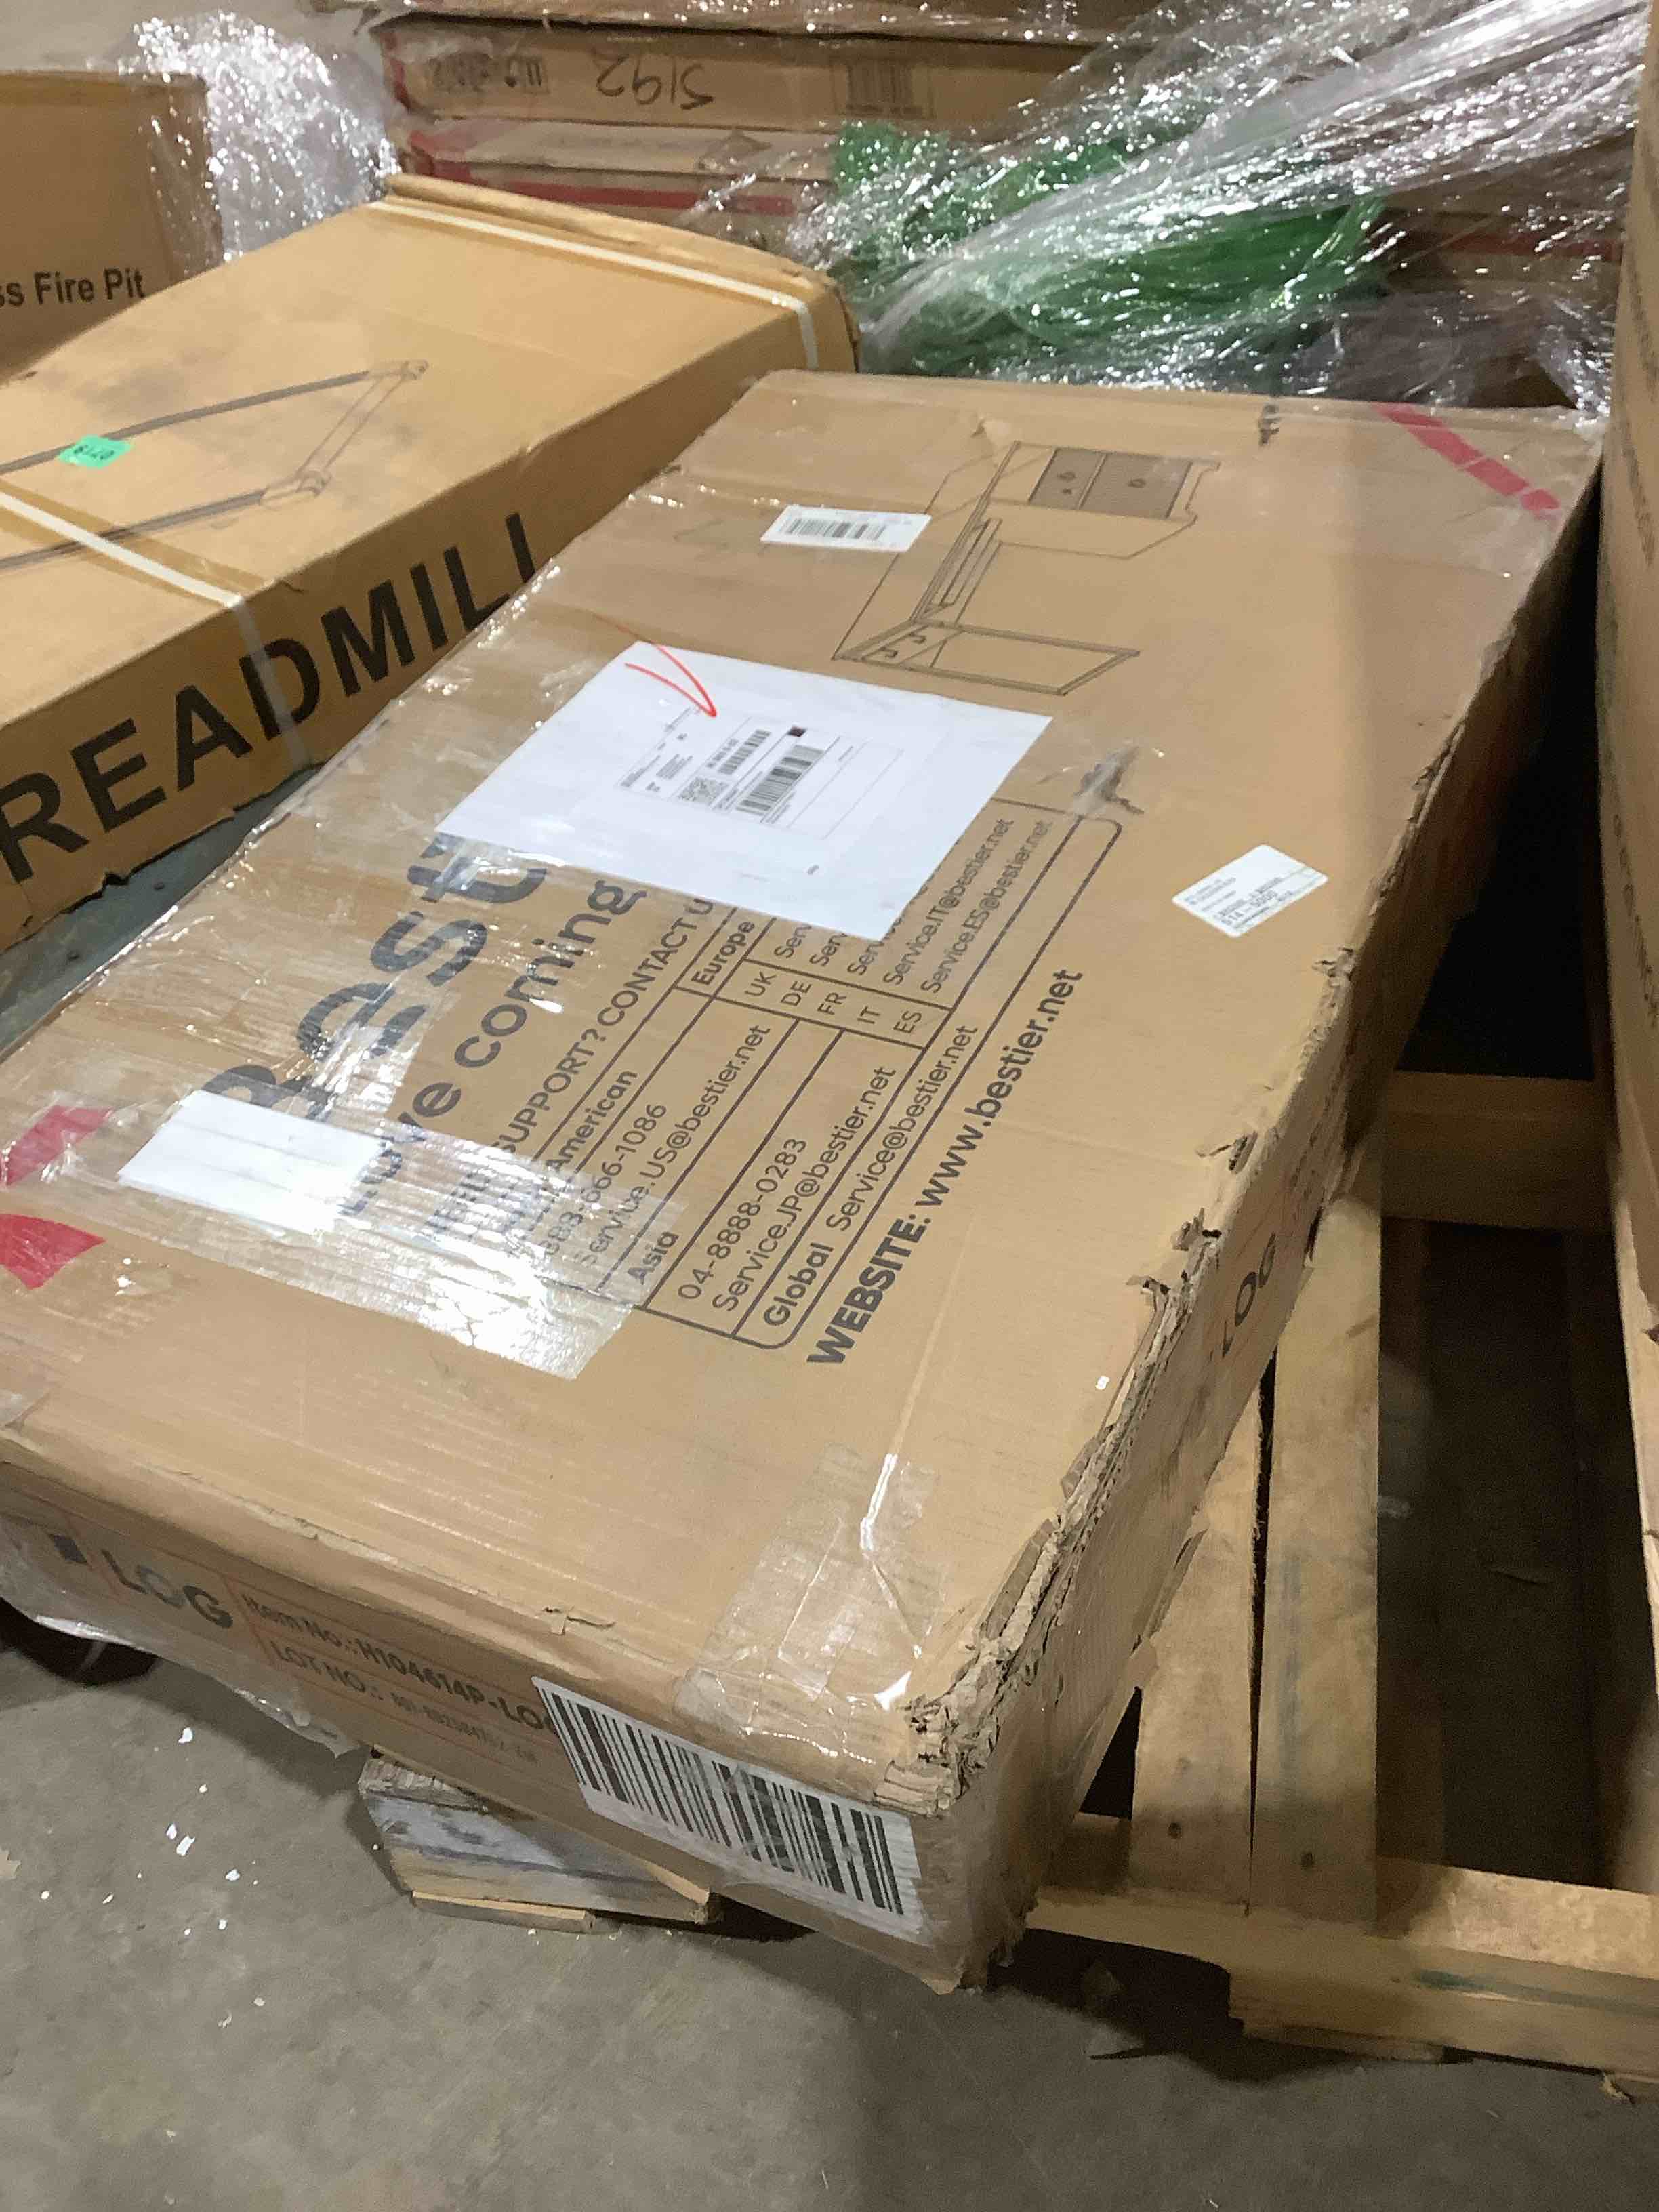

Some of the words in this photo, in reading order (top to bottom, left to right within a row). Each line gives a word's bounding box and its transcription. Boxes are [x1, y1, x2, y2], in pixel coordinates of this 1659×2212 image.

[34, 270, 94, 304] Fire
[104, 267, 145, 300] Pit
[691, 921, 756, 985] Europe
[883, 819, 1015, 986] Service.IT@bestier.net
[920, 820, 1053, 994] Service.ES@bestier.net
[453, 880, 647, 1069] coming
[745, 971, 777, 996] UK
[781, 981, 812, 1006] DE
[817, 991, 847, 1016] FR
[857, 1006, 882, 1025] IT
[893, 1010, 923, 1034] ES
[493, 1027, 607, 1155] SUPPORT?
[597, 917, 697, 1026] CONTACT
[546, 1070, 638, 1172] American
[573, 1024, 772, 1267] Service.US@bestier.net
[806, 1214, 932, 1364] WEBSITE:
[914, 968, 1084, 1211] www.bestier.net
[678, 1138, 807, 1299] 04-8888-0283
[712, 1066, 897, 1312] Service.JP@bestier.net
[763, 1242, 834, 1326] Global
[826, 1024, 979, 1231] Service@bestier.net
[628, 1231, 679, 1285] Asia
[270, 1639, 322, 1675] LOT
